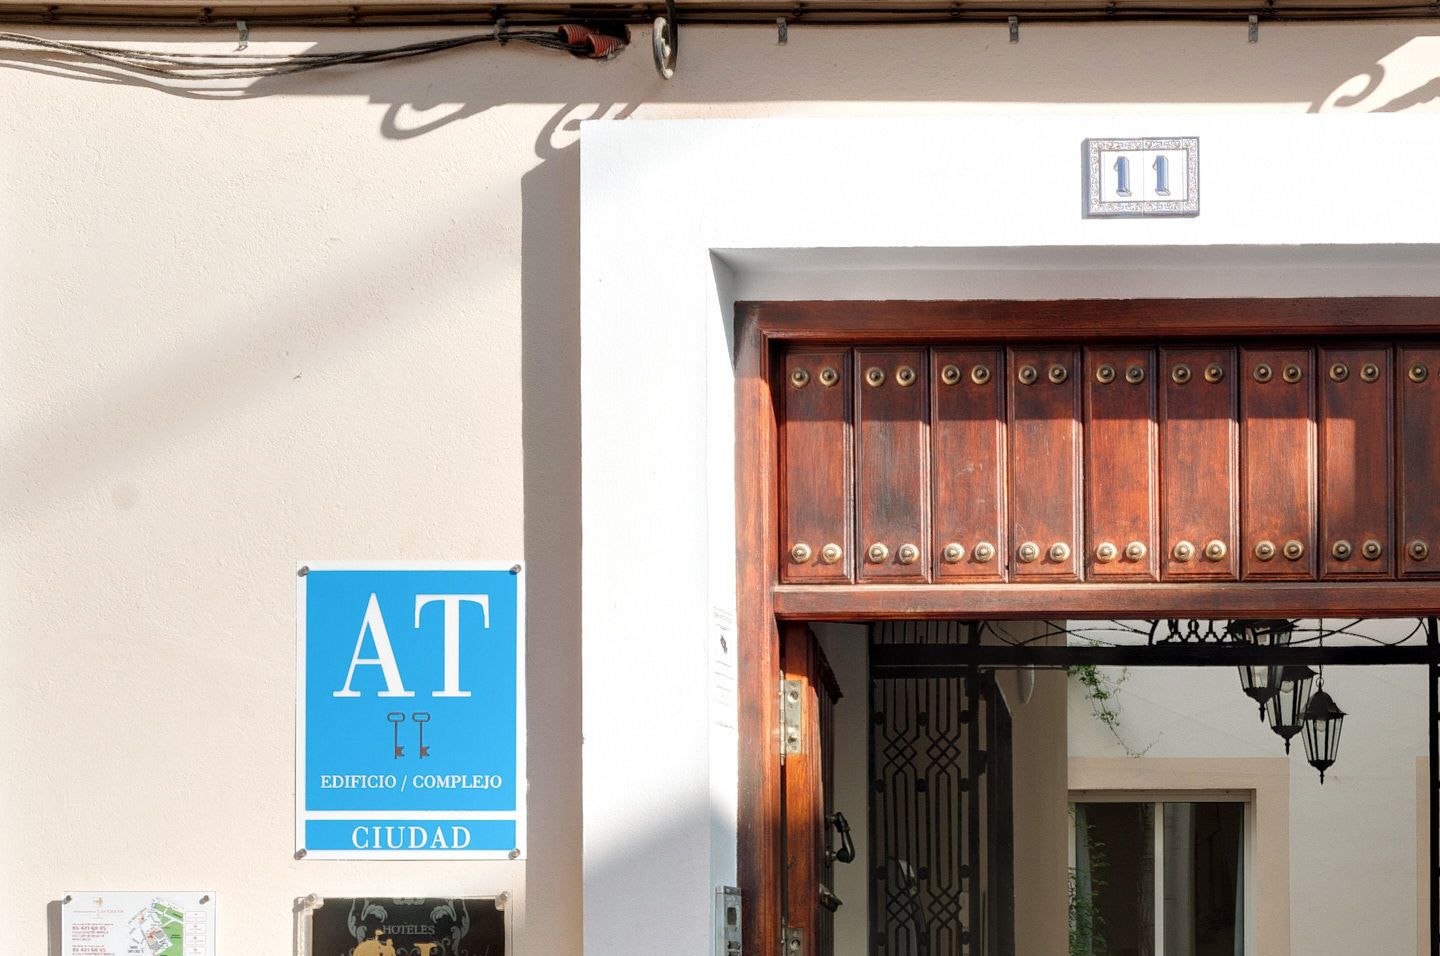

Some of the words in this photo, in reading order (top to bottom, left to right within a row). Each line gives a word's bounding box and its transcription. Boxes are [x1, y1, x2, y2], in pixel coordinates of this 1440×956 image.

[1113, 155, 1171, 197] 11
[332, 591, 490, 698] AT
[319, 774, 397, 790] EDIFICIO
[412, 774, 503, 790] COMPLEJO
[352, 825, 471, 850] CIUDAD
[382, 924, 436, 936] HOTELES
